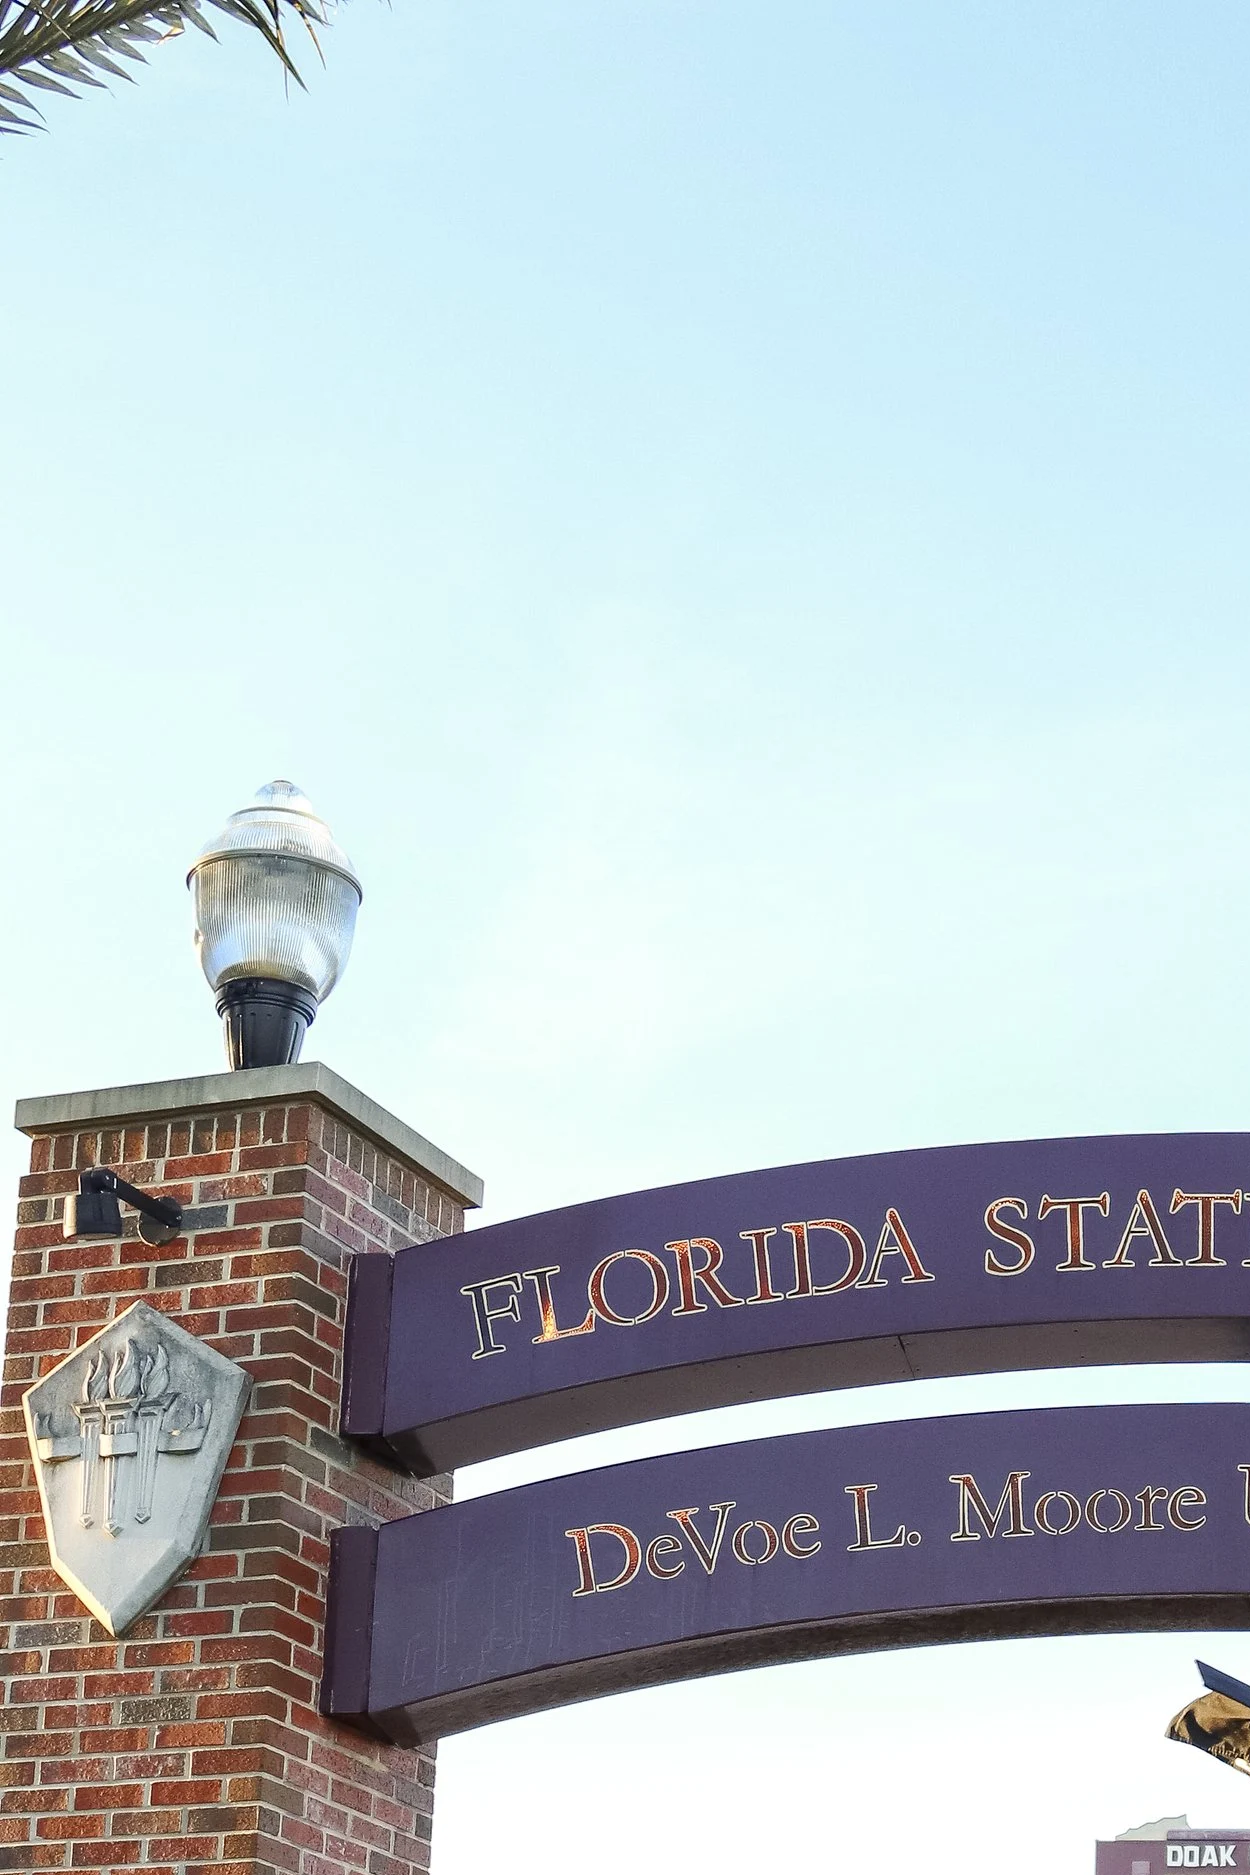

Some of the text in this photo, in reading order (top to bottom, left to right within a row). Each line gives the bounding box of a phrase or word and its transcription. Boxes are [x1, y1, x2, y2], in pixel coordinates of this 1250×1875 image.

[460, 1207, 935, 1361] FLORIDA
[564, 1501, 822, 1598] DeVoe
[844, 1483, 922, 1552] L.
[948, 1470, 1207, 1542] Moore
[1166, 1845, 1237, 1868] DOAK
